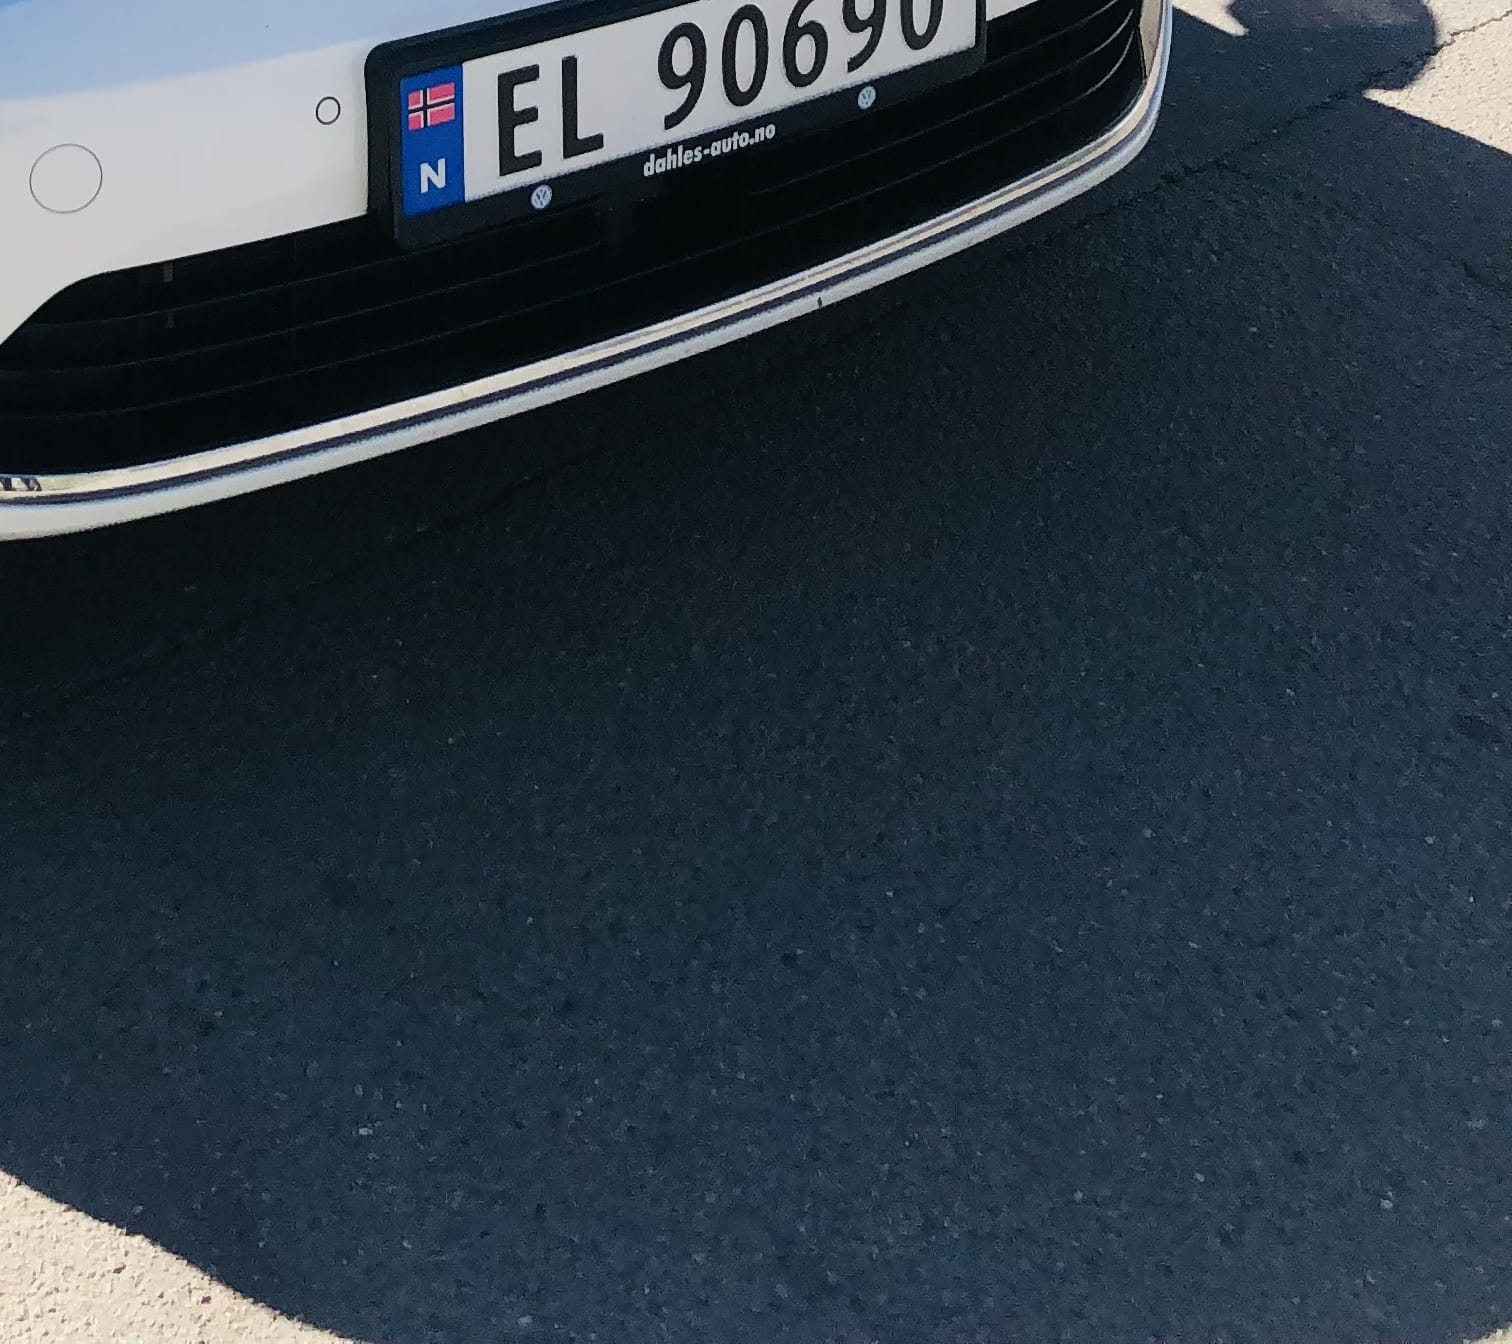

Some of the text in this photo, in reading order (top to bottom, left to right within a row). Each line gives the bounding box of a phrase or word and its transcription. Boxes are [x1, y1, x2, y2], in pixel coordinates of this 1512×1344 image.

[497, 54, 604, 177] EL
[420, 158, 446, 194] N
[643, 123, 776, 177] dahles-auto.no
